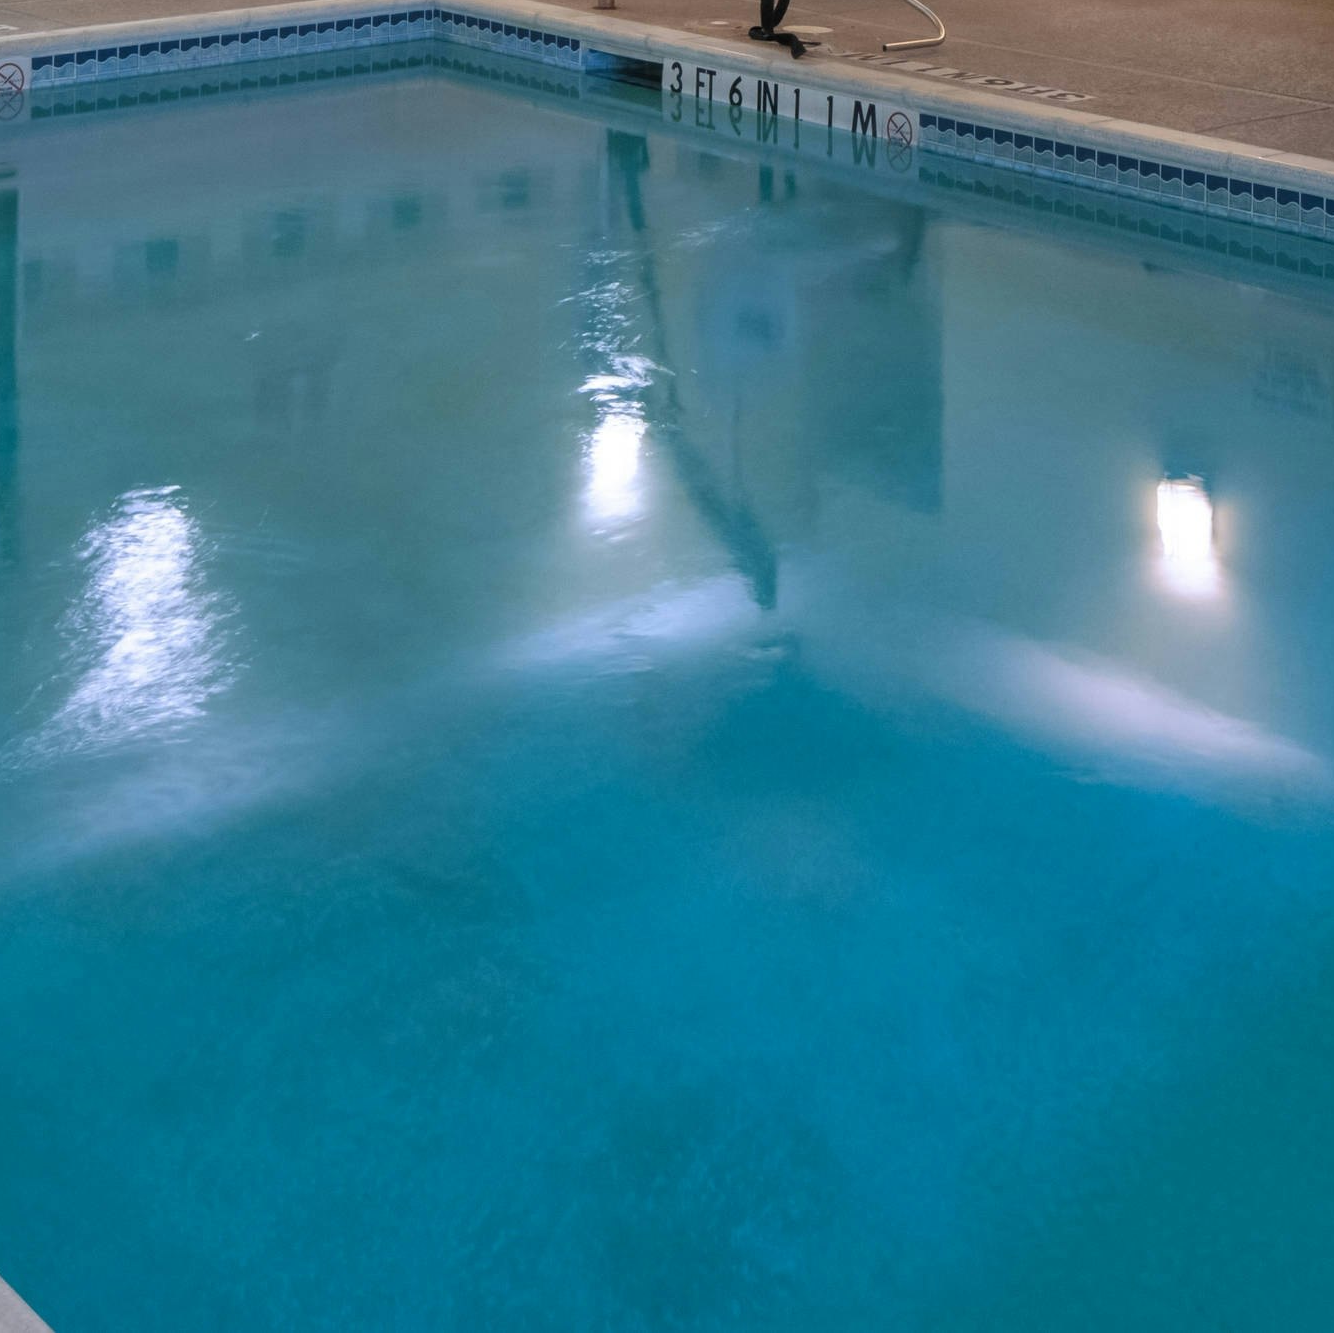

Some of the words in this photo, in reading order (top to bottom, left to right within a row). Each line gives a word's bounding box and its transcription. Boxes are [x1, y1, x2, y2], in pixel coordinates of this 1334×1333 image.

[670, 62, 682, 93] 3
[696, 67, 716, 102] FT
[729, 76, 742, 106] 6
[757, 79, 778, 115] IN
[827, 95, 834, 127] 1
[851, 100, 877, 138] M
